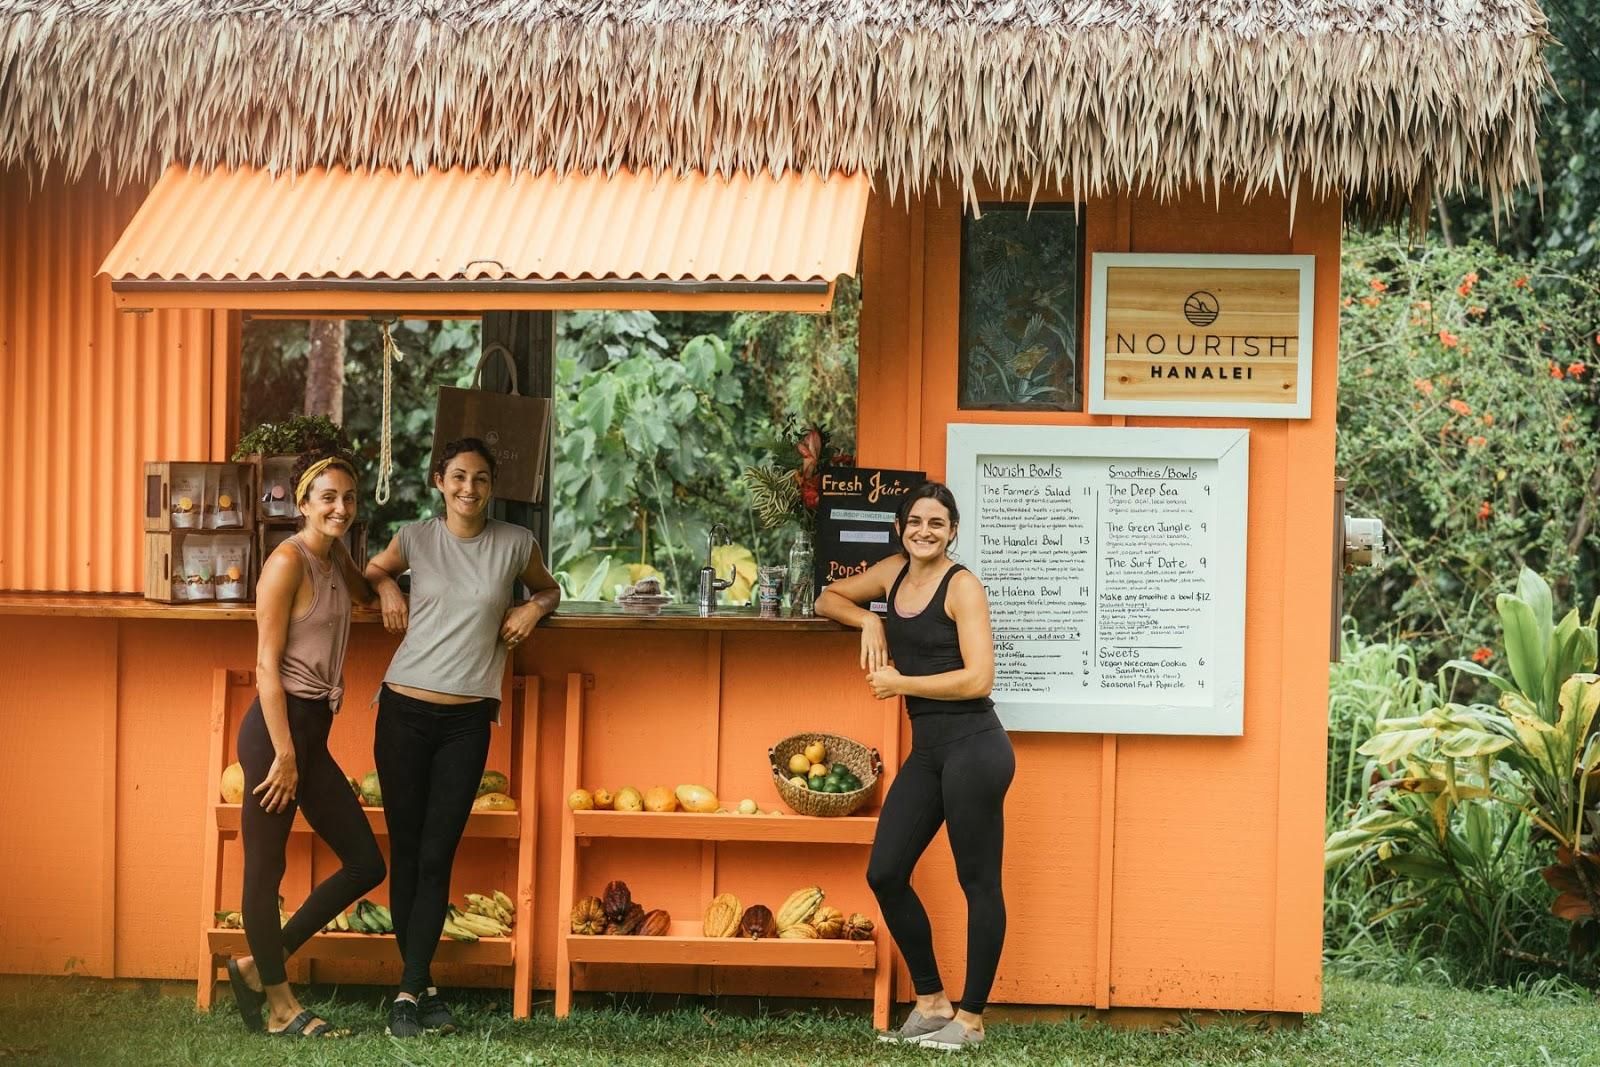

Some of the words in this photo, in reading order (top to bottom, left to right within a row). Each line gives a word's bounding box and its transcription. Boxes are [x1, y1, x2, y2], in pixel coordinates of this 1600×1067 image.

[1116, 333, 1287, 357] NOURISH
[1151, 366, 1251, 379] HANALEI
[983, 463, 1024, 478] Nourish
[1029, 463, 1062, 477] Bowls
[822, 474, 862, 492] Fresh
[981, 485, 1000, 495] The
[1003, 484, 1040, 495] Farmer's
[1045, 485, 1071, 496] Salad
[1084, 487, 1091, 496] 11
[1106, 484, 1127, 495] The
[1131, 484, 1156, 497] Deep
[1160, 483, 1178, 496] Sea
[1204, 485, 1210, 495] 9
[1104, 522, 1124, 532] The
[1128, 522, 1154, 532] Green
[1158, 522, 1191, 532] Jungle
[1201, 522, 1206, 532] 9
[980, 535, 1000, 545] The
[1003, 536, 1037, 546] Hanalei
[1042, 534, 1063, 545] Bowl
[1080, 537, 1090, 545] 13
[1105, 558, 1127, 568] The
[1130, 556, 1154, 568] Surf
[1158, 557, 1187, 568] Date
[1200, 557, 1206, 568] 9
[1041, 586, 1061, 596] Bowl
[1080, 586, 1088, 596] 14
[1100, 593, 1121, 601] Make
[1179, 592, 1193, 600] bowl
[1196, 592, 1211, 601] $12
[993, 642, 1014, 650] inks
[1099, 647, 1139, 658] Sweets
[1199, 658, 1205, 666] 6
[1156, 681, 1185, 689] Popsicle
[1198, 680, 1204, 688] 4
